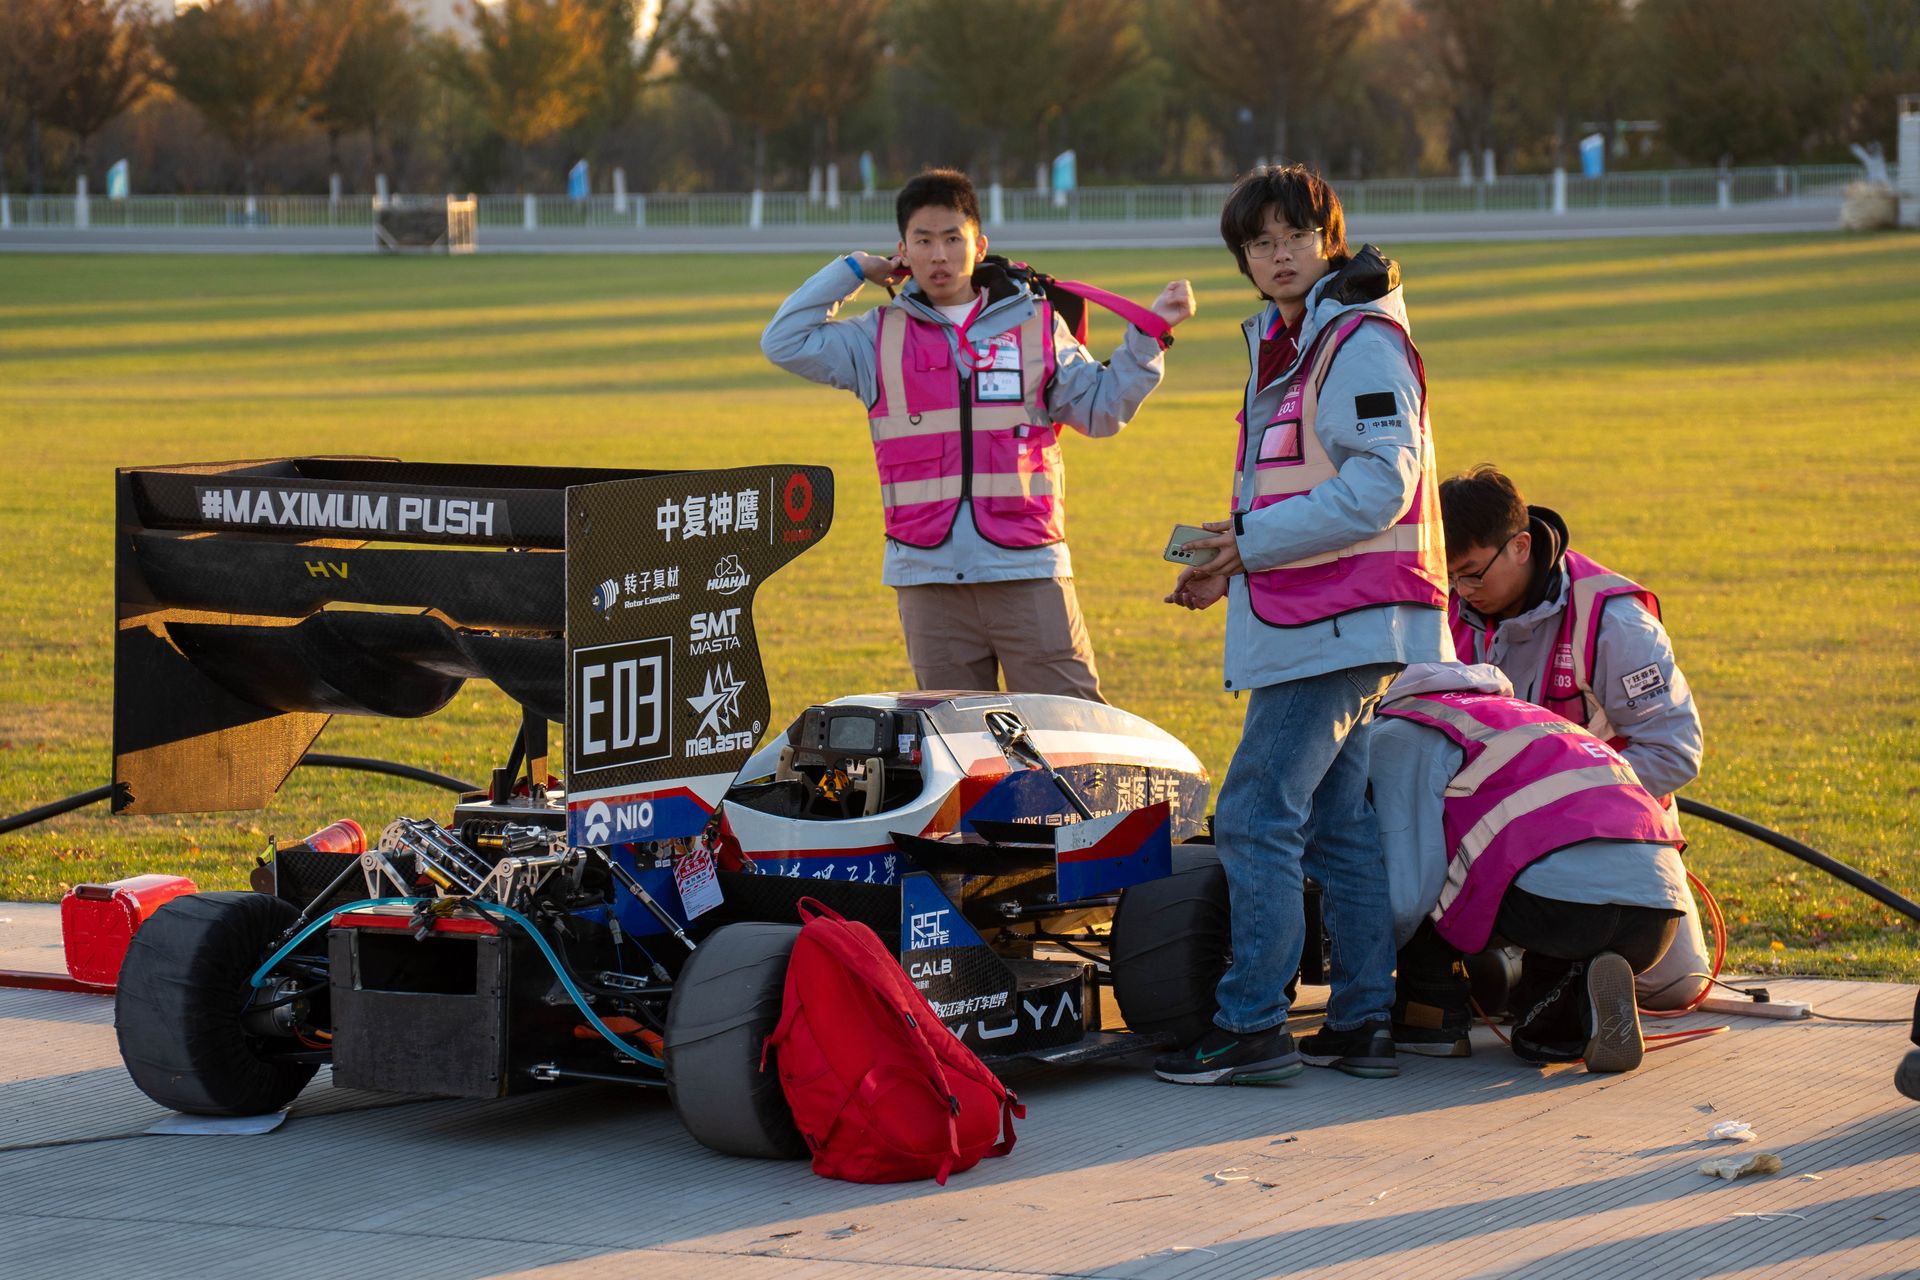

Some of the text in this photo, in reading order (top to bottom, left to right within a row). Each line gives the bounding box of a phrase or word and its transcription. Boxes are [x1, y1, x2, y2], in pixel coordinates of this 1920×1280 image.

[202, 489, 494, 536] #MAXIMUM PUSH
[656, 488, 760, 542] 中复神鹰
[304, 560, 348, 578] HV
[624, 566, 680, 595] 转子复材
[706, 574, 751, 591] HUAHAI
[690, 608, 742, 641] SMT
[690, 636, 741, 656] MASTA
[1554, 674, 1572, 688] E03
[616, 802, 653, 832] NIO
[910, 958, 952, 978] CALB
